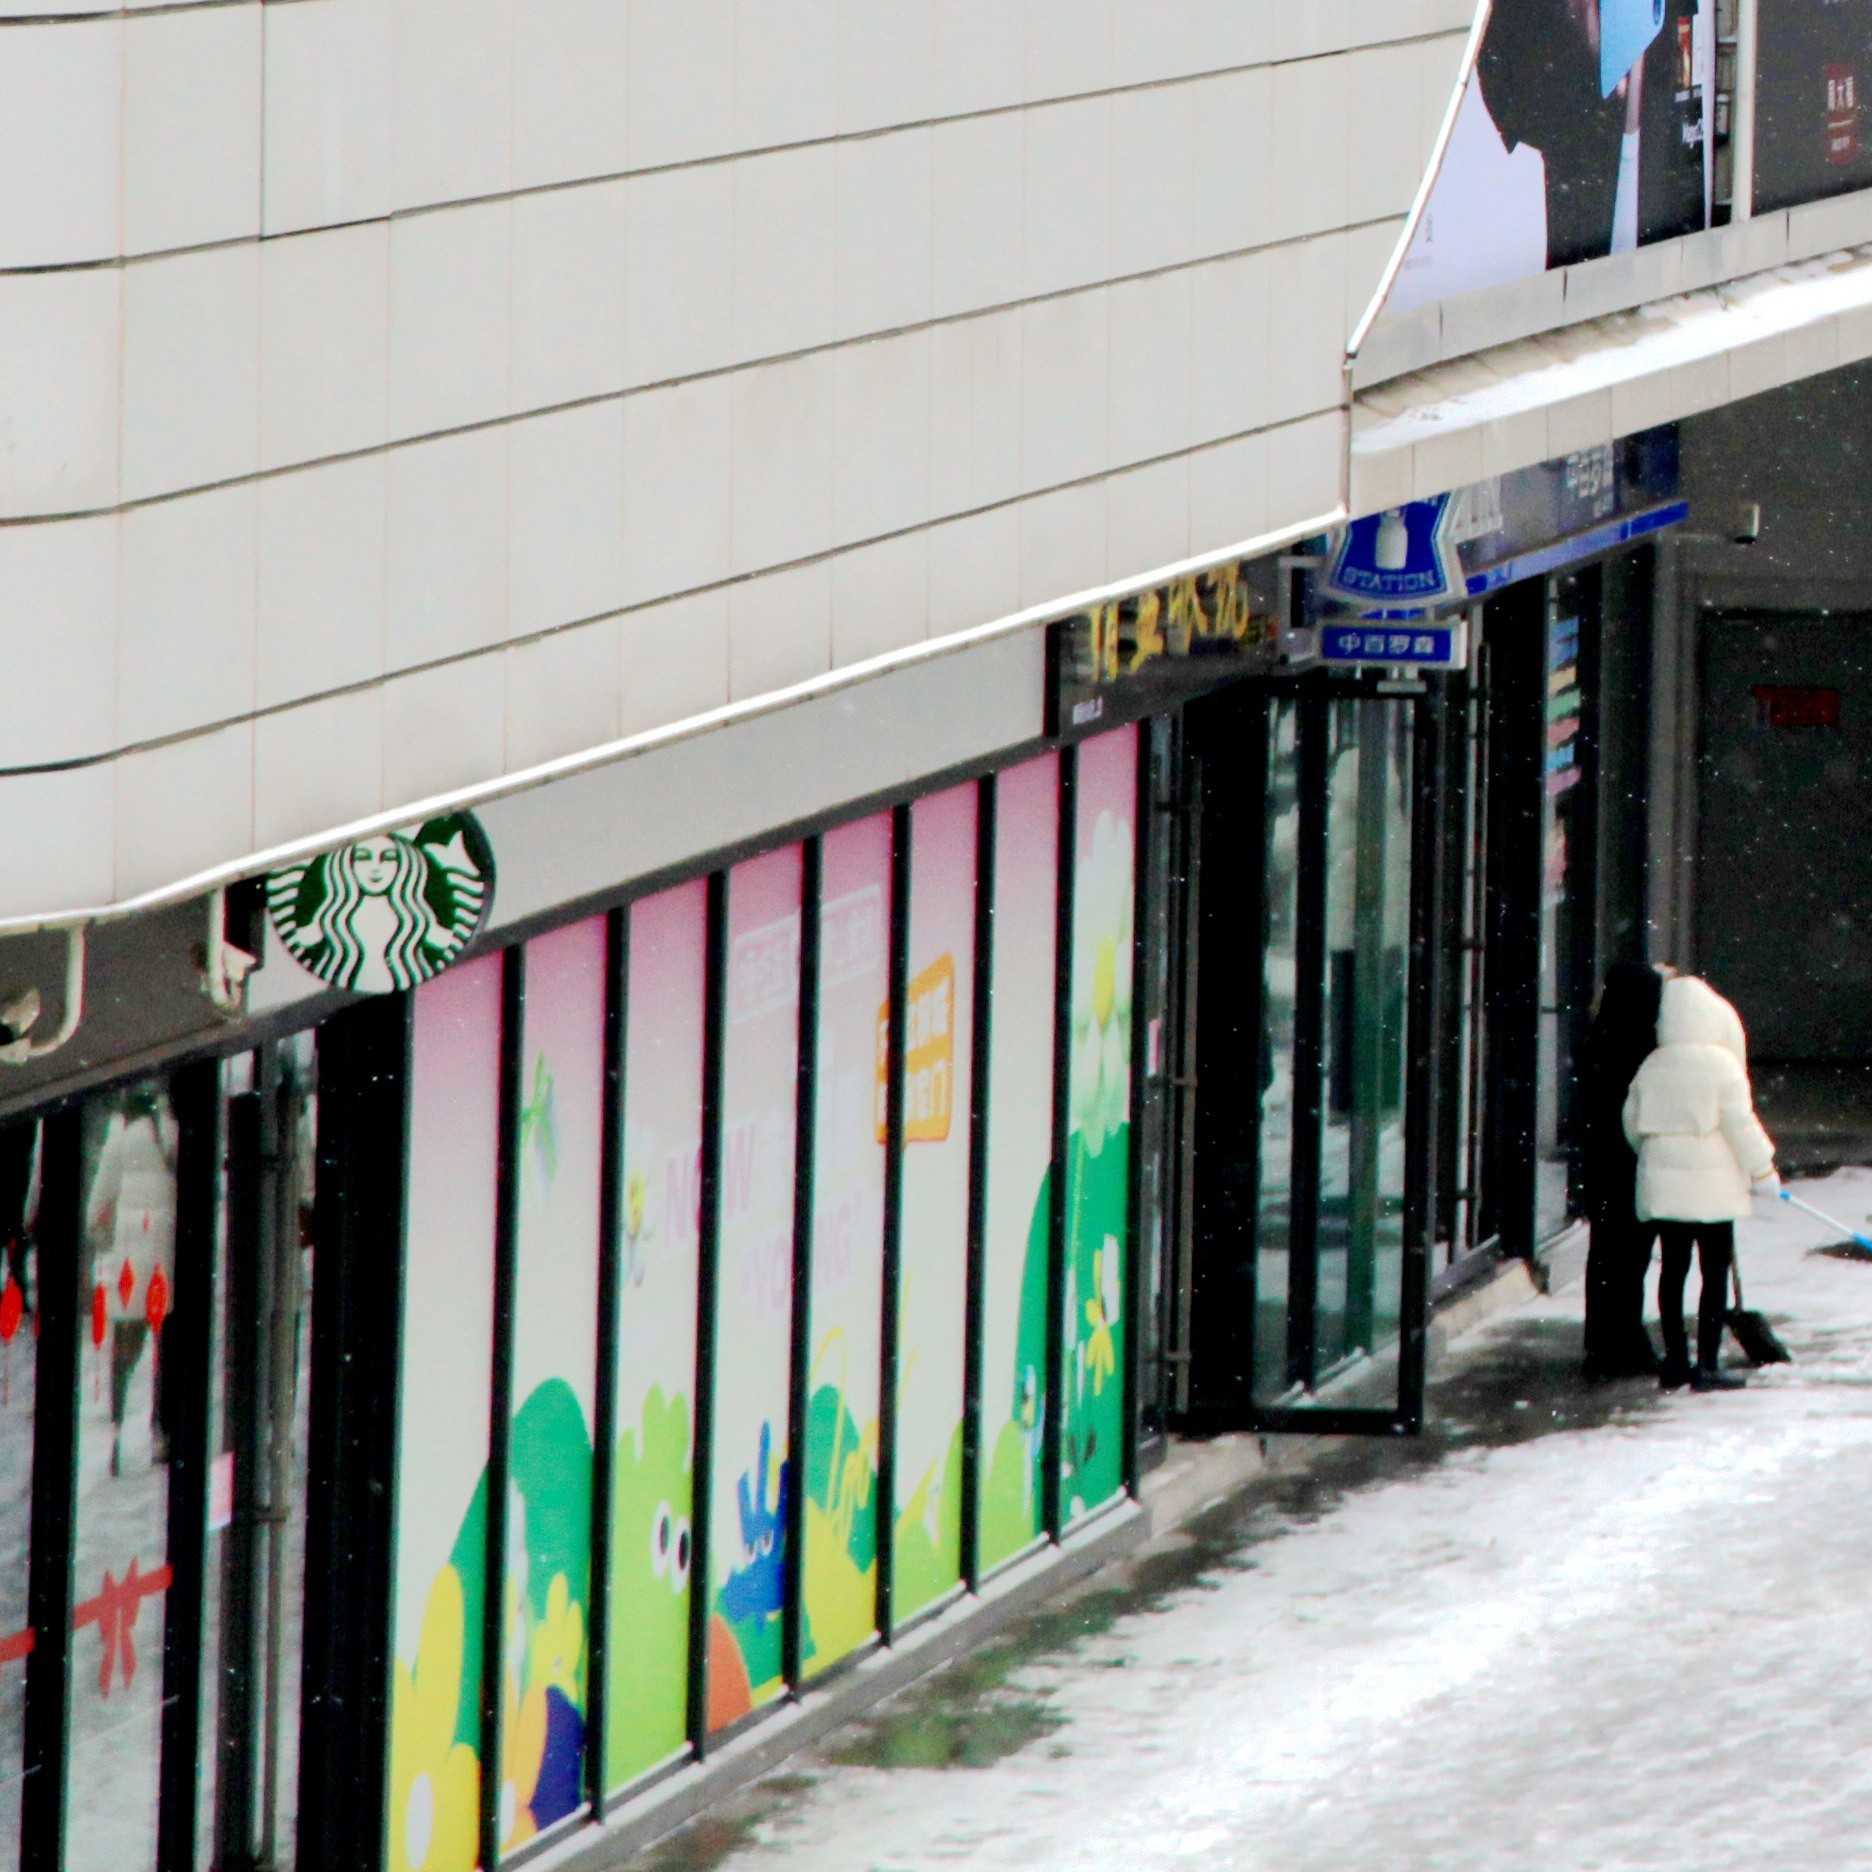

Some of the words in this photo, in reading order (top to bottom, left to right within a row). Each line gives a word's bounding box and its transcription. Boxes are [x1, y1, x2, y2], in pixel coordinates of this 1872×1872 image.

[1342, 566, 1436, 593] STATION
[1338, 631, 1435, 655] 中百罗森
